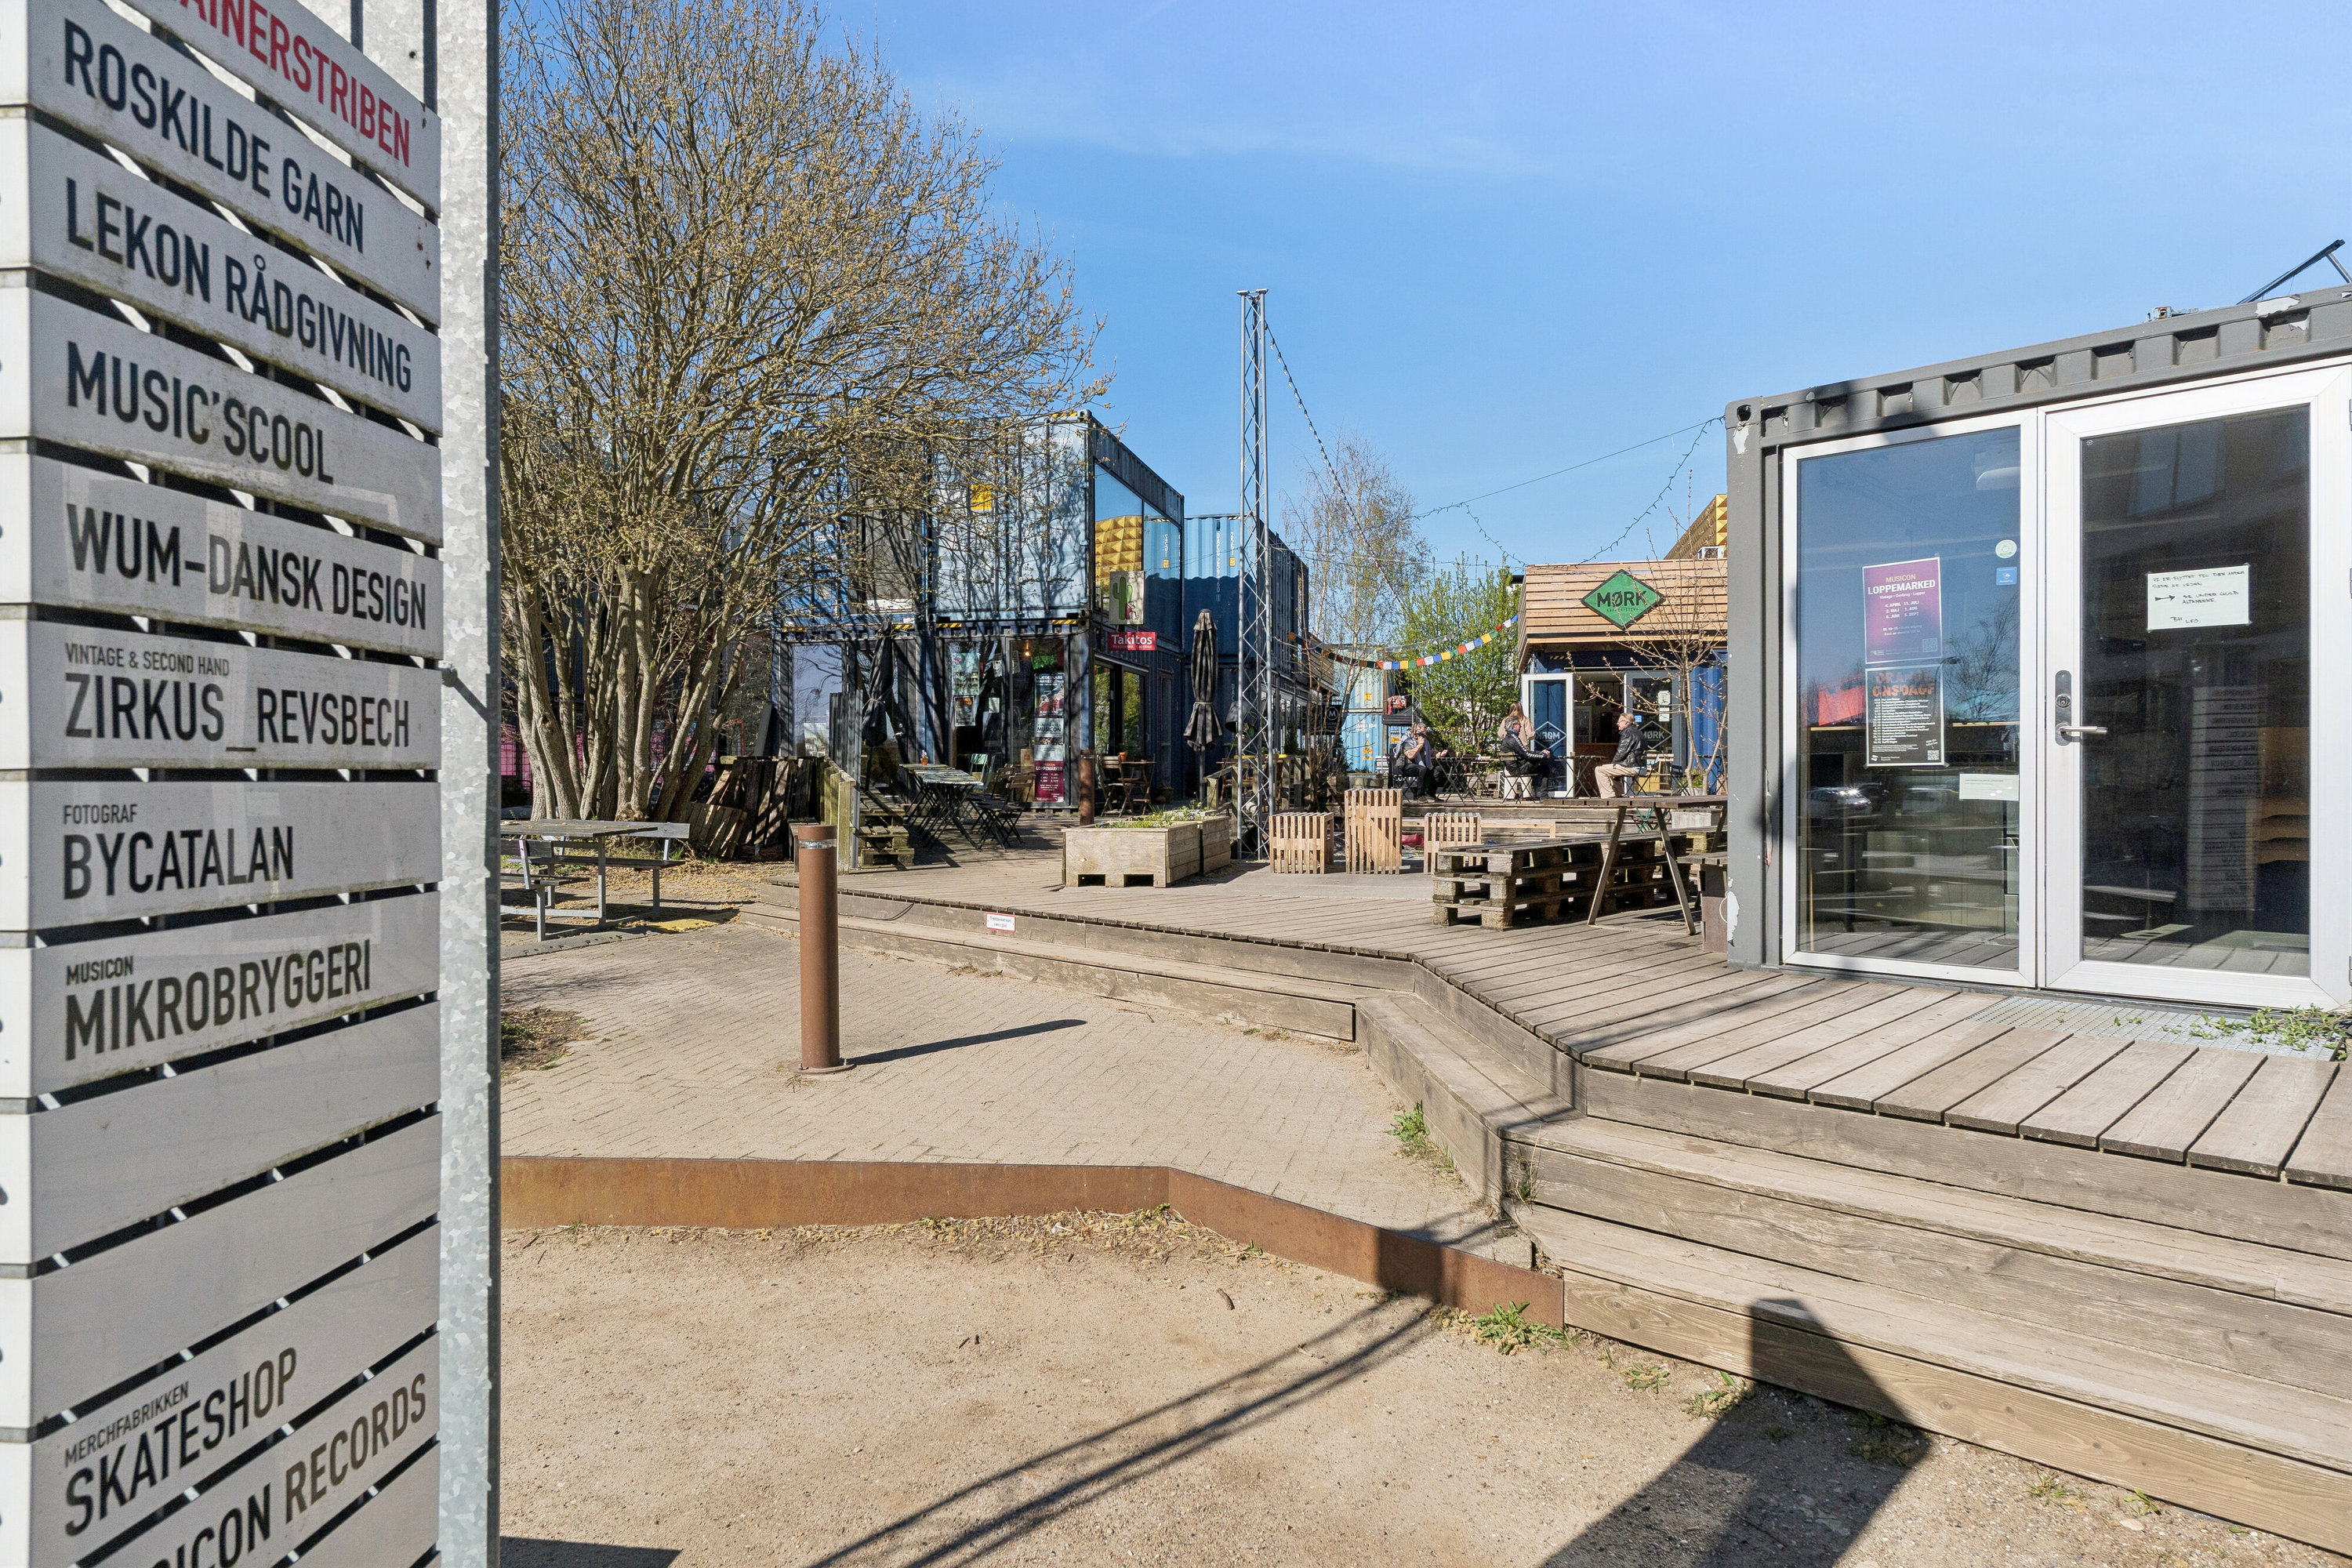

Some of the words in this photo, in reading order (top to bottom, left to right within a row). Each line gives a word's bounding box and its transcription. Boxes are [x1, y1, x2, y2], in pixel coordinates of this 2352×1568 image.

[180, 0, 410, 167] NERSTRIBEN
[64, 18, 270, 198] ROSKILDE
[283, 157, 364, 254] GARN
[67, 178, 210, 303] LEKON
[226, 255, 411, 393] RÅDGIVNING
[332, 562, 426, 630] DESIGN
[1596, 590, 1647, 608] MØRK
[1867, 579, 1936, 594] LOPPEMARKED
[1886, 573, 1916, 583] MUSICON
[65, 643, 125, 666] VINTAGE
[129, 651, 139, 668] &
[143, 651, 194, 673] SECOND
[198, 656, 230, 676] HAND
[1111, 633, 1153, 644] Takitos
[64, 804, 137, 825] FOTOGRAF
[63, 826, 294, 899] BYCATALAN
[66, 939, 371, 1061] MIKROBRYGGERI
[67, 955, 133, 985] MUSICON
[64, 1381, 189, 1468] MERCHFABRIKKEN
[66, 1347, 297, 1536] SKATESHOP
[285, 1373, 426, 1523] RECORDS
